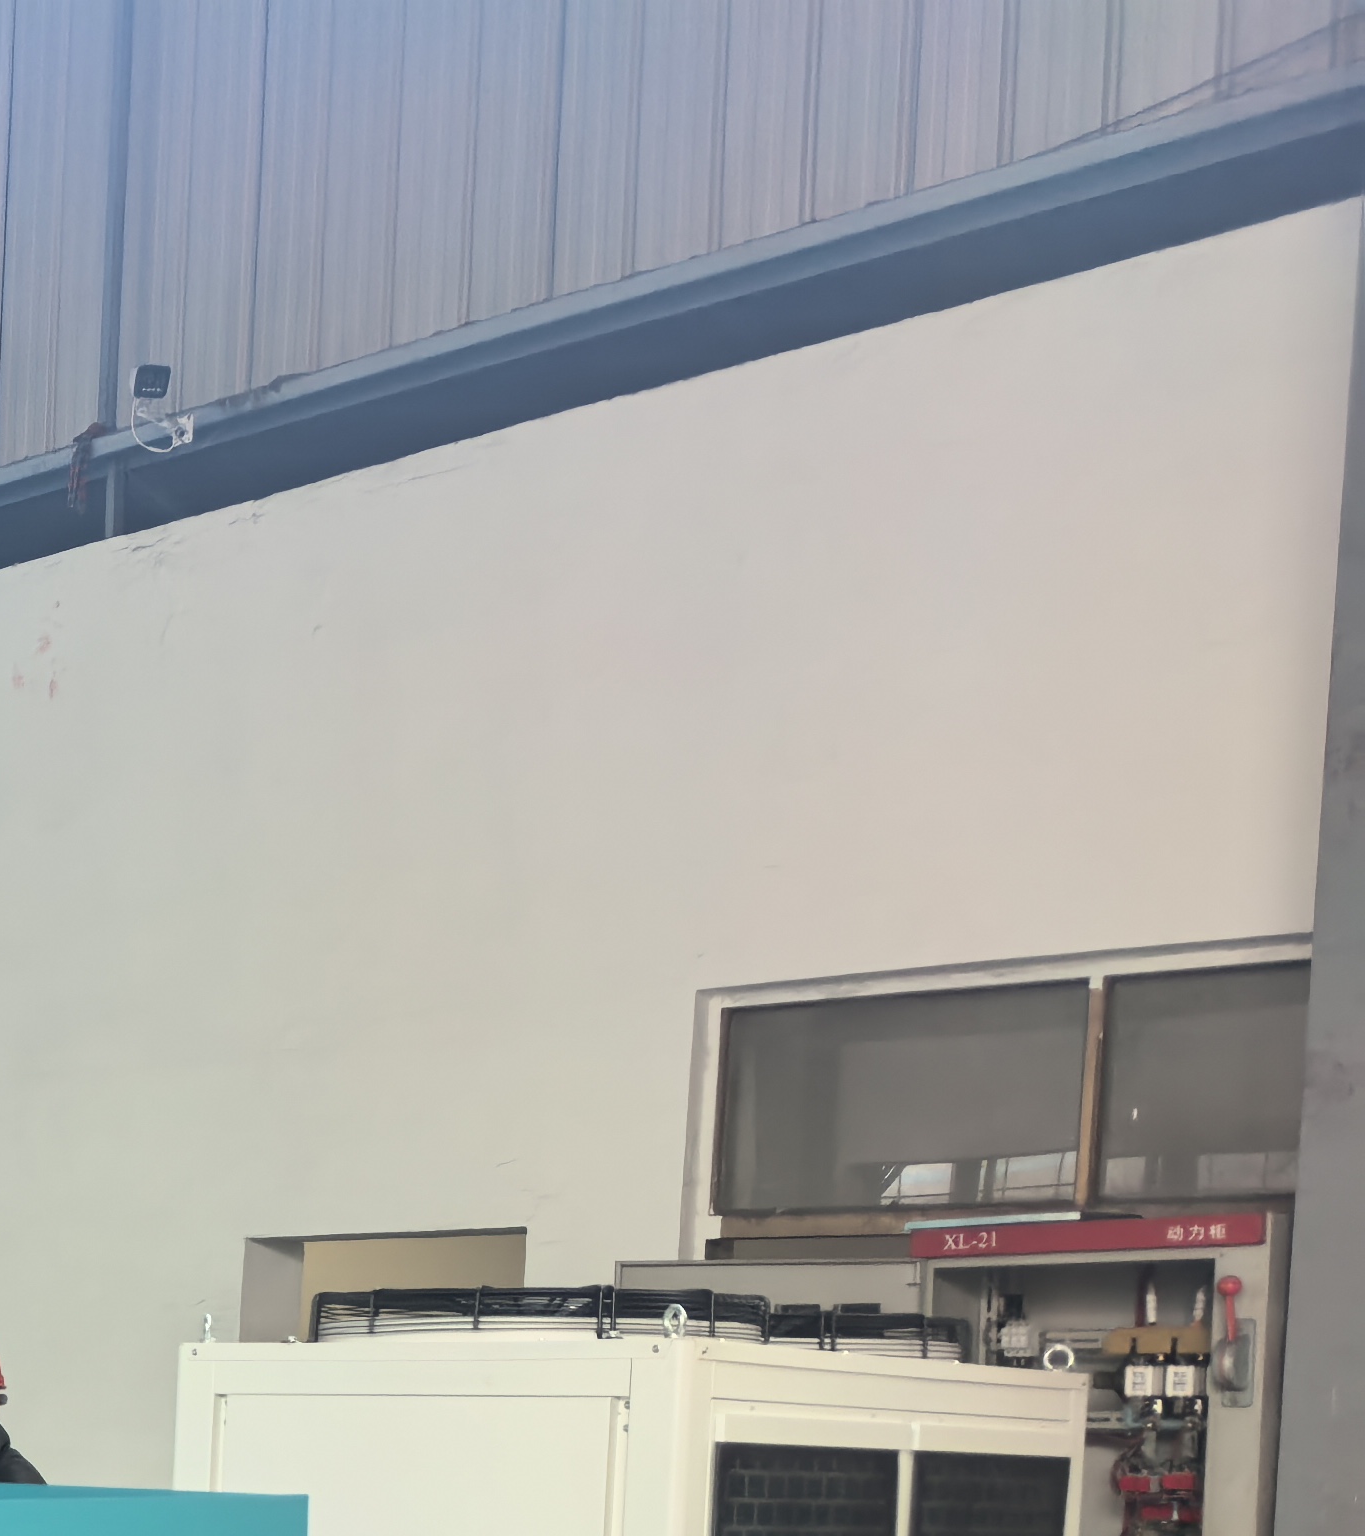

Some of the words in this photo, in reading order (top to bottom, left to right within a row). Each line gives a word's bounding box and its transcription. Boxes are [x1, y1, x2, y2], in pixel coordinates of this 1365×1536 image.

[943, 1231, 996, 1250] XL-21
[1167, 1224, 1226, 1241] 动力柜
